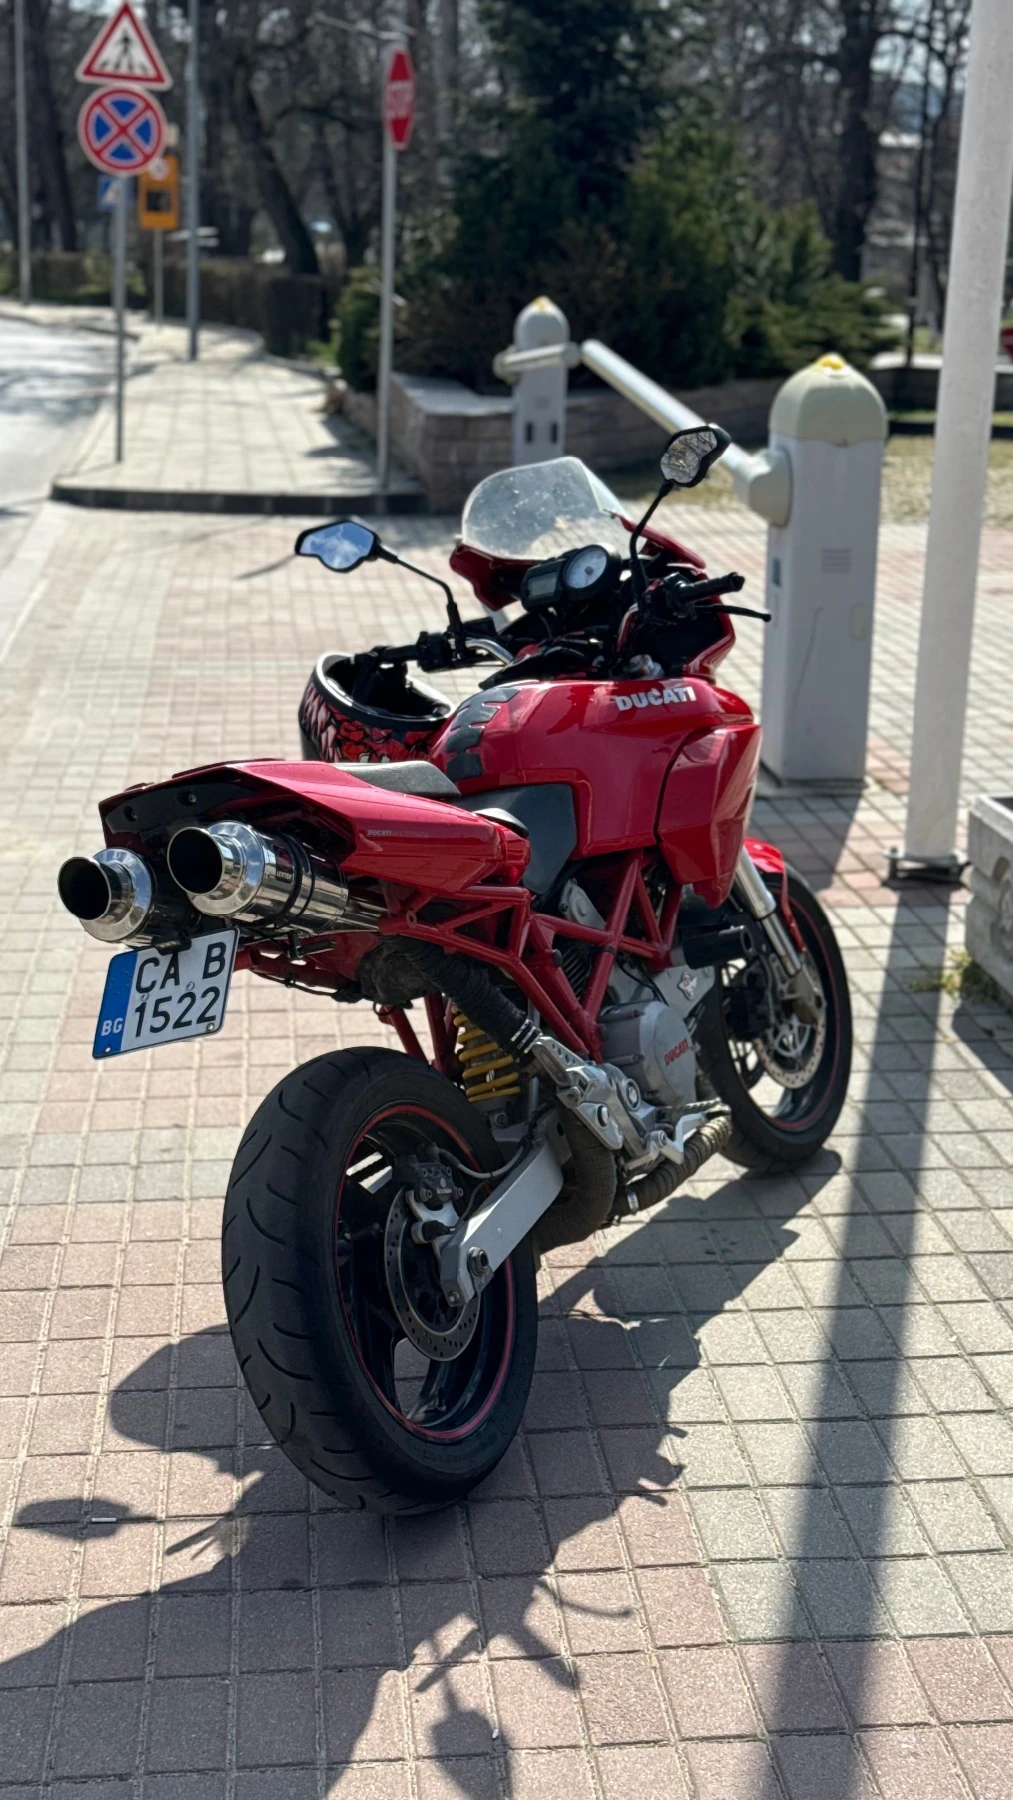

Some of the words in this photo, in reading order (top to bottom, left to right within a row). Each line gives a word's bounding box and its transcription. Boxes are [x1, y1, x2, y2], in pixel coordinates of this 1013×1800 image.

[615, 686, 697, 711] DUCATI
[367, 829, 392, 837] DUCATI
[135, 952, 180, 994] CA
[202, 942, 227, 980] B
[135, 986, 221, 1038] 1522
[101, 1017, 124, 1037] BG
[664, 1038, 689, 1067] DUCATI
